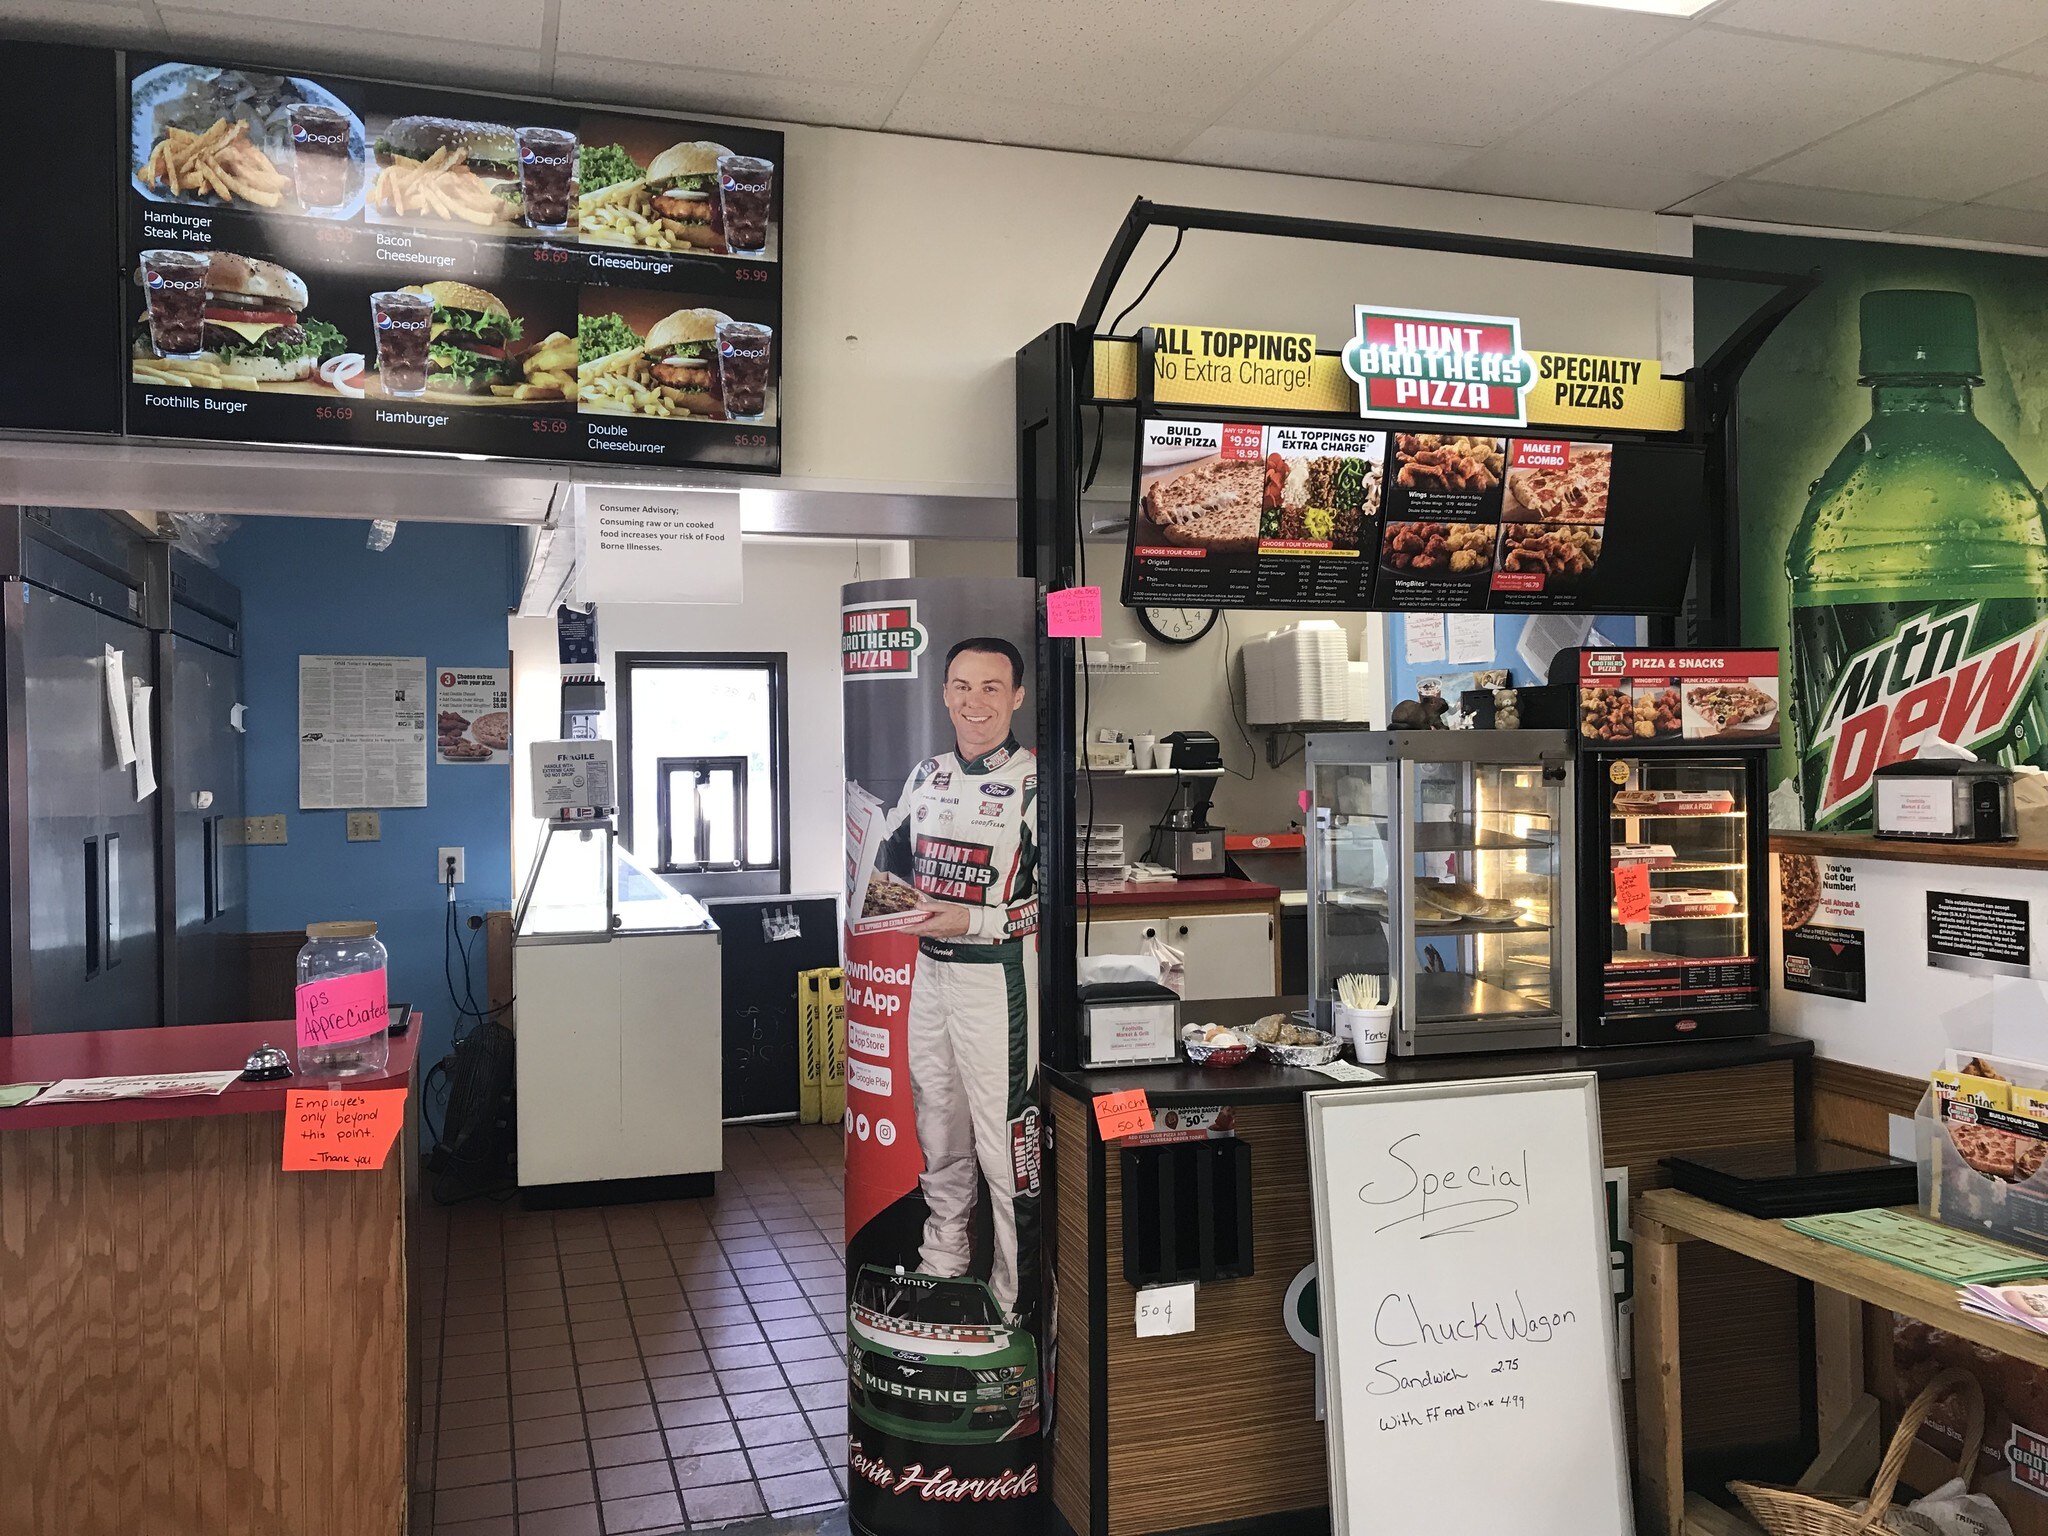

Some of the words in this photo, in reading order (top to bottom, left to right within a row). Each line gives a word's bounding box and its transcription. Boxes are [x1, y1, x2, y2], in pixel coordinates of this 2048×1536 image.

[307, 132, 344, 145] pepsi
[535, 154, 569, 166] pepsi
[735, 182, 767, 193] pepsi
[144, 210, 212, 228] Hamburger
[144, 226, 178, 240] Steak
[183, 226, 211, 242] Plate
[376, 234, 411, 247] Bacon
[376, 249, 456, 267] Cheeseburger
[533, 250, 568, 263] $6.69
[589, 255, 673, 274] Cheeseburger
[736, 268, 767, 282] $5.99
[163, 278, 202, 292] pepsi
[392, 319, 426, 331] pepsi
[1154, 327, 1193, 355] ALL
[1201, 330, 1312, 363] TOPPINGS
[1394, 323, 1483, 353] HUNT
[733, 348, 765, 359] pepsi
[1359, 346, 1522, 384] BROTHERS
[1540, 355, 1641, 385] SPECIALTY
[1154, 357, 1177, 379] No
[1185, 358, 1231, 383] Extra
[1240, 361, 1311, 392] Charge!
[1396, 378, 1490, 410] PIZZA
[1555, 382, 1624, 410] PIZZAS
[145, 394, 200, 409] Foothills
[204, 398, 248, 413] Burger
[316, 406, 353, 420] $6.69
[376, 410, 449, 427] Hamburger
[532, 420, 567, 434] $5.69
[588, 424, 628, 436] Double
[1167, 426, 1201, 436] BUILD
[735, 434, 766, 446] $6.99
[1150, 436, 1182, 446] YOUR
[1185, 438, 1217, 447] PIZZA
[1230, 436, 1259, 447] $9.99
[1278, 430, 1297, 439] ALL
[1301, 431, 1355, 442] TOPPINGS
[1359, 435, 1375, 443] NO
[588, 439, 665, 454] Cheeseburger
[1236, 449, 1258, 458] $8.99
[1282, 441, 1317, 450] EXTRA
[1321, 442, 1366, 452] CHARGE
[1523, 443, 1551, 453] MAKE
[1553, 445, 1562, 454] IT
[1518, 456, 1525, 464] A
[1527, 456, 1564, 466] COMBO
[1409, 491, 1427, 499] Wings
[600, 504, 640, 513] Consumer
[600, 518, 644, 528] Consuming
[600, 530, 619, 538] food
[621, 531, 658, 539] increases
[600, 542, 625, 550] Borne
[626, 543, 662, 551] Illnesses.
[1152, 609, 1160, 618] 8
[849, 613, 890, 633] HUNT
[850, 650, 892, 669] PIZZA
[1632, 659, 1665, 668] PIZZA
[1668, 659, 1676, 668] &
[1679, 659, 1724, 668] SNACKS
[445, 675, 450, 685] 3
[1823, 614, 1969, 733] Mtn
[1039, 670, 1048, 821] BROTHERS
[986, 783, 1010, 796] Ford
[925, 842, 973, 864] HUNT
[1039, 827, 1048, 905] HUNT
[1826, 864, 1851, 873] You've
[1824, 873, 1837, 881] Got
[1839, 874, 1854, 882] Our
[921, 875, 966, 897] PIZZA
[1823, 882, 1856, 891] Number!
[1820, 898, 1831, 906] Call
[1833, 900, 1853, 908] Ahead
[1825, 907, 1842, 916] Carry
[295, 981, 328, 1011] Tips
[845, 980, 861, 1005] Our
[863, 987, 900, 1016] App
[304, 997, 387, 1042] Appreciated
[1365, 1029, 1387, 1041] Forks
[855, 1035, 865, 1047] App
[866, 1038, 884, 1051] Store
[855, 1072, 875, 1086] Google
[875, 1073, 890, 1089] Play
[1936, 1081, 1961, 1092] New!
[295, 1096, 365, 1113] Employee's
[301, 1111, 327, 1126] only
[336, 1109, 379, 1126] beyond
[1989, 1112, 2006, 1120] BUILD
[2007, 1116, 2022, 1125] YOUR
[2023, 1121, 2039, 1129] PIZZA
[301, 1128, 326, 1141] this
[337, 1128, 375, 1142] point.
[1014, 1137, 1028, 1178] HUNT
[1025, 1115, 1040, 1189] BROTHERS
[354, 1154, 371, 1167] you
[1359, 1133, 1531, 1222] Special
[889, 1276, 937, 1290] xfinity
[1374, 1293, 1497, 1347] Chuck
[1496, 1289, 1576, 1342] Wagon
[897, 1351, 921, 1362] Ford
[1365, 1359, 1469, 1395] Sandwich
[1491, 1358, 1520, 1375] 2.75
[866, 1373, 967, 1403] MUSTANG
[1379, 1410, 1423, 1431] With
[1426, 1406, 1440, 1421] FF
[1444, 1405, 1465, 1417] And
[1468, 1399, 1495, 1412] Drink
[1501, 1396, 1525, 1409] 4.99
[1924, 1416, 1945, 1433] Actual
[894, 1464, 1037, 1499] Harvick
